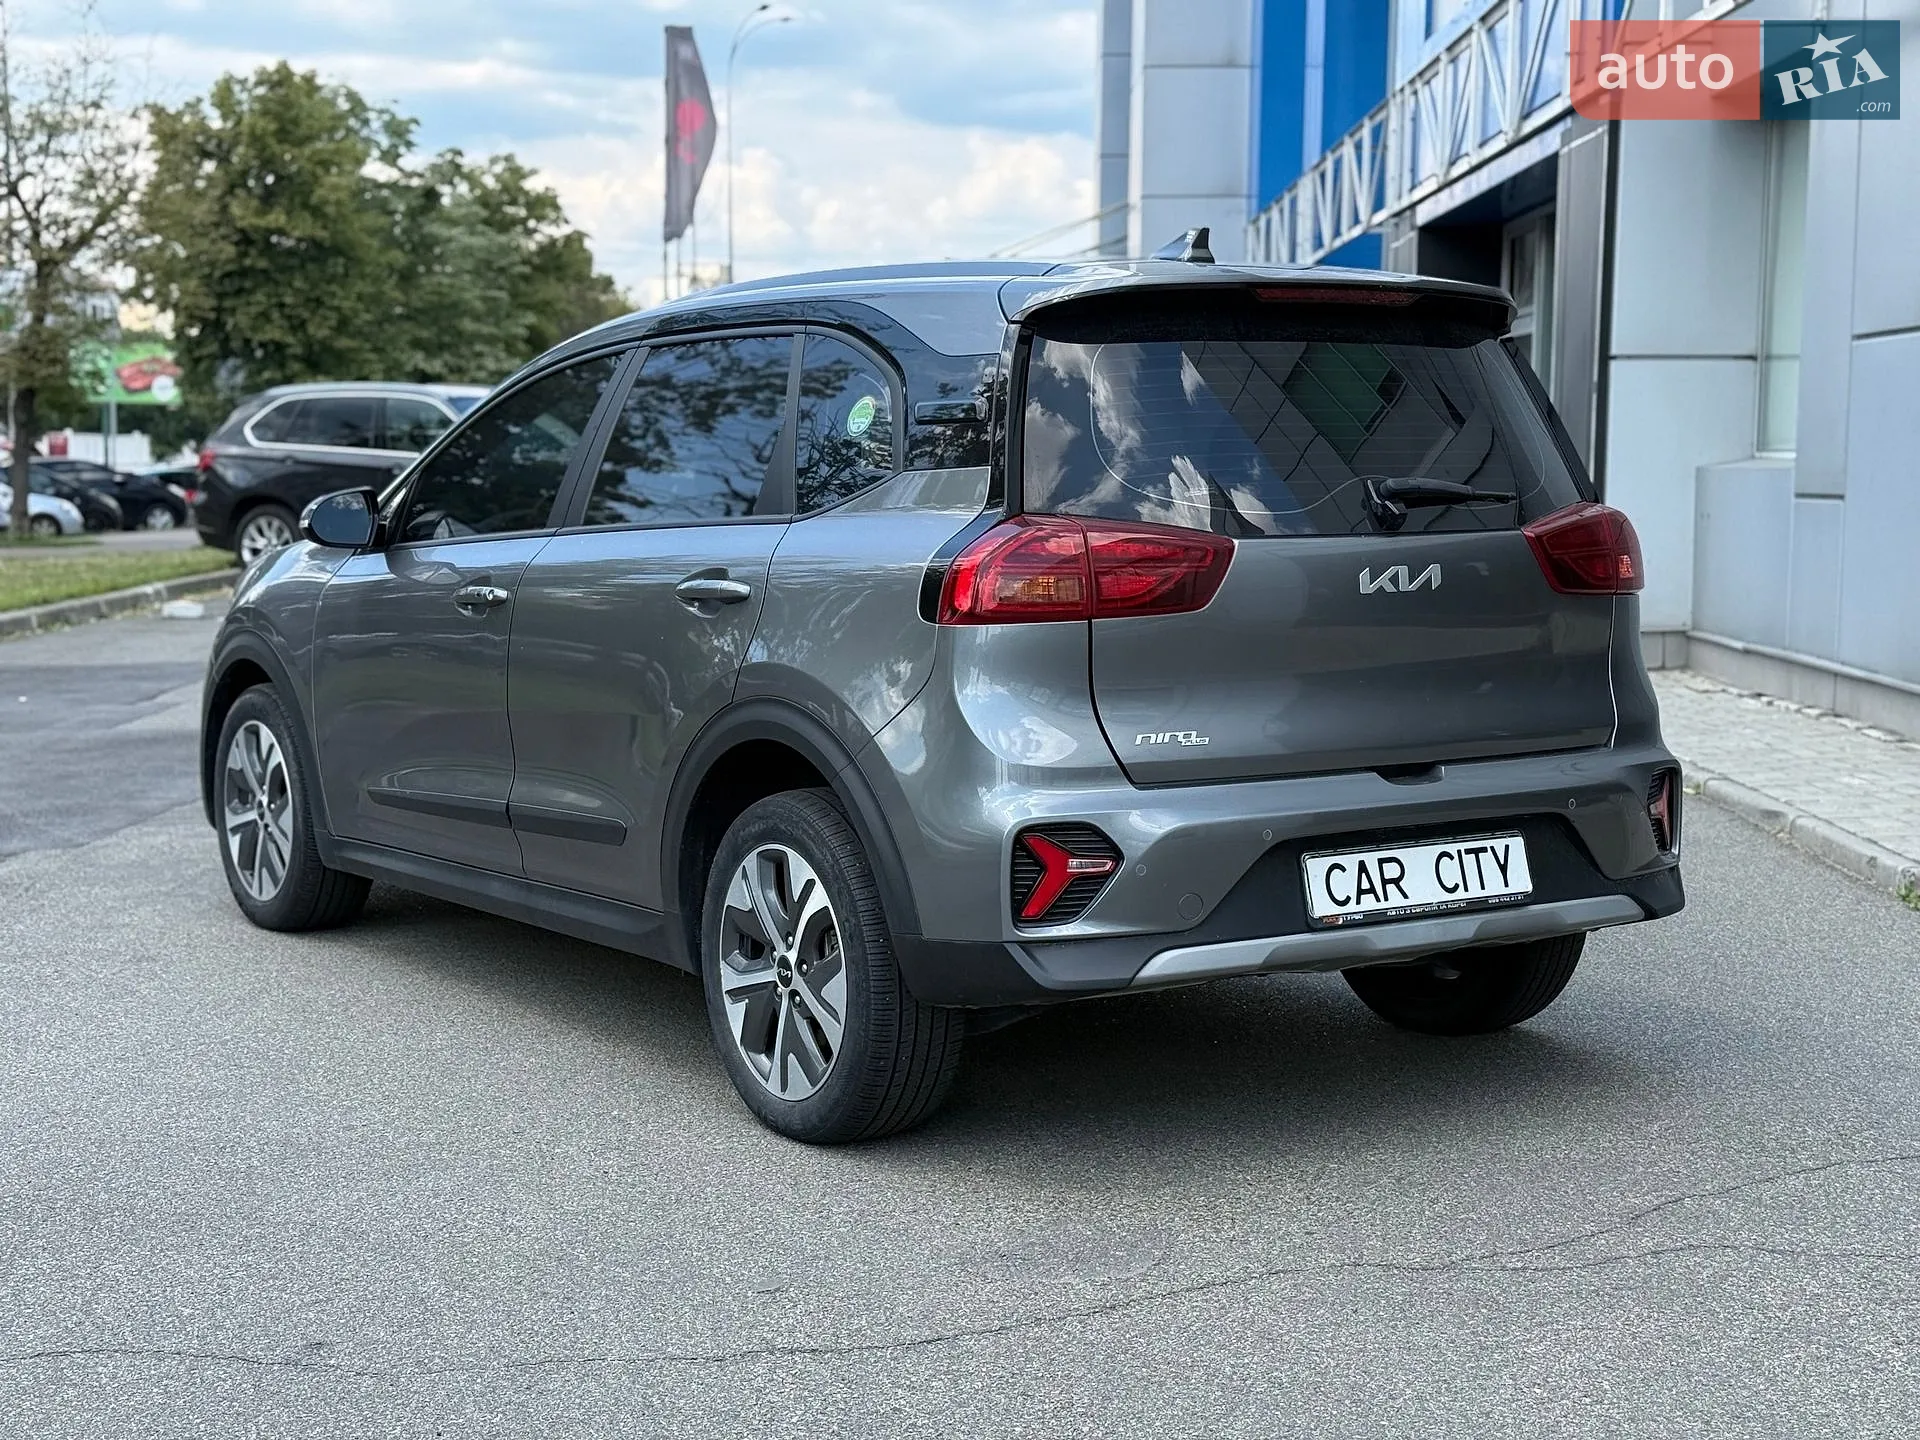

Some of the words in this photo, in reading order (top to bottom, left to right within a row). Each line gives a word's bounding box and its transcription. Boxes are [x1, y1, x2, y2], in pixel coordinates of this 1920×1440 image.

[1359, 563, 1442, 594] KIA
[1325, 856, 1410, 907] CAR
[1434, 844, 1510, 894] CITY
